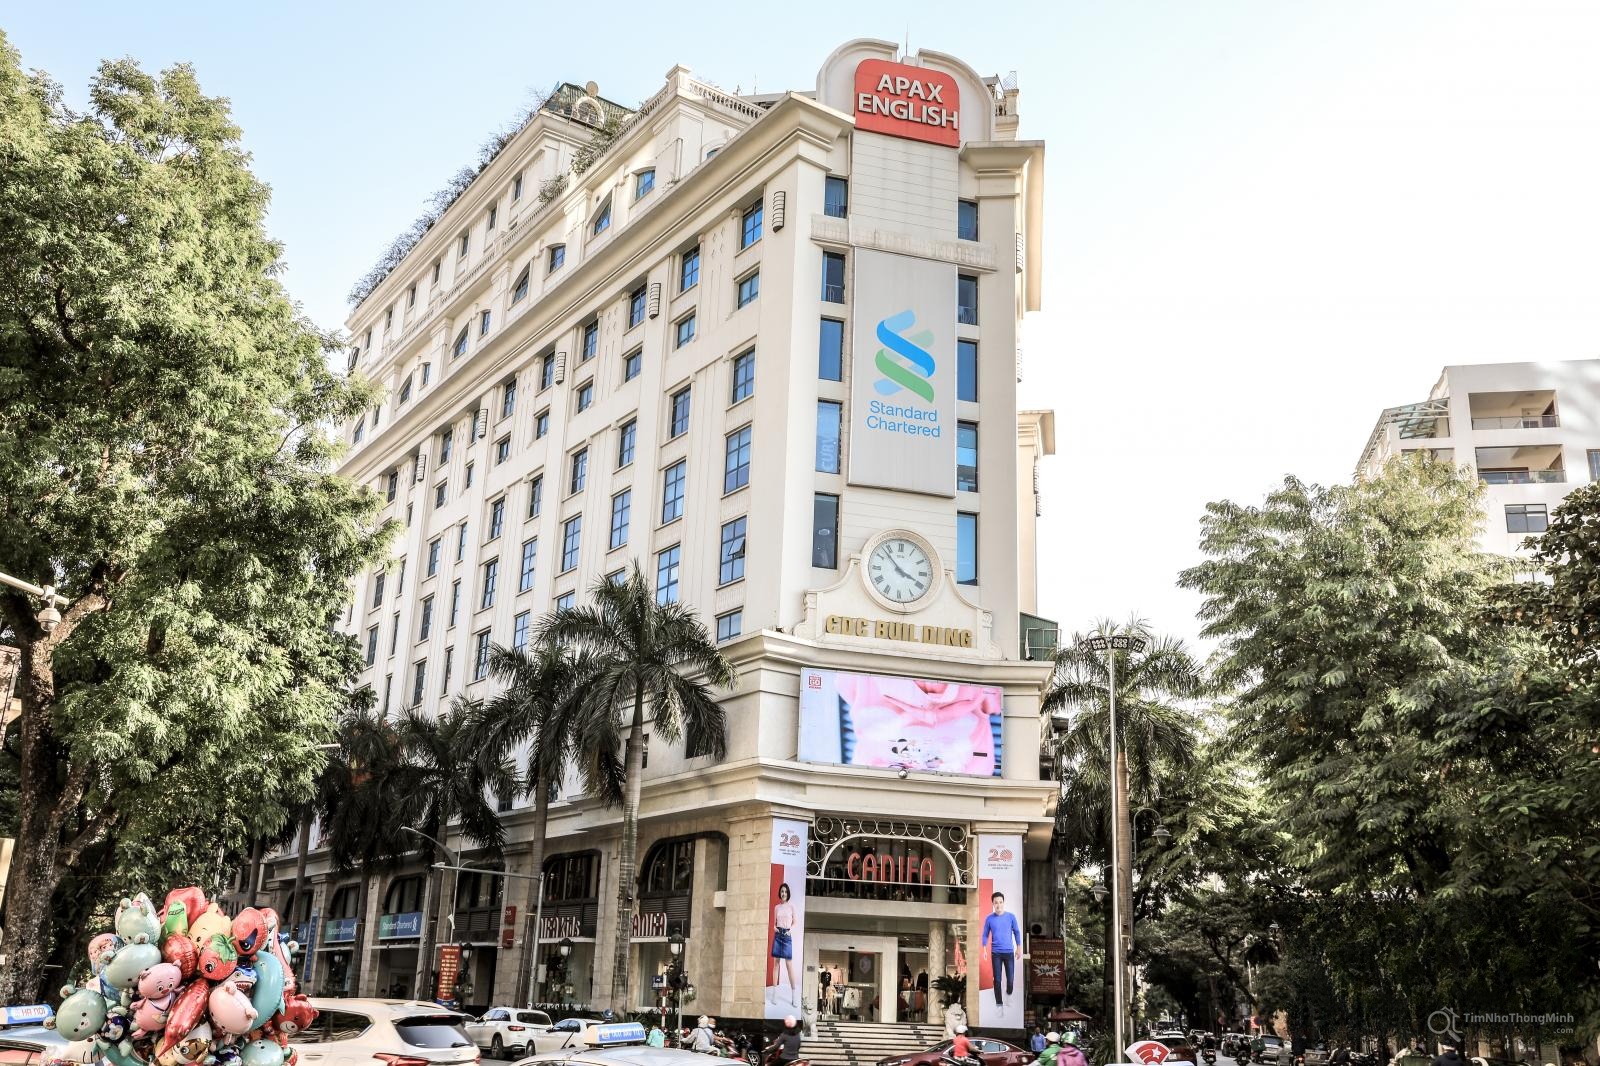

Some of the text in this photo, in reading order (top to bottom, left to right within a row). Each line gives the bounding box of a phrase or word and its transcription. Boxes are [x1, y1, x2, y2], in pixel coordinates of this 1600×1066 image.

[876, 73, 943, 104] APAX
[858, 92, 958, 130] ENGLISH
[866, 415, 941, 438] Chartered
[870, 400, 937, 422] Standard
[826, 615, 973, 648] CDC BUILDING
[847, 852, 935, 885] CANIFA
[632, 912, 667, 937] ANIFA
